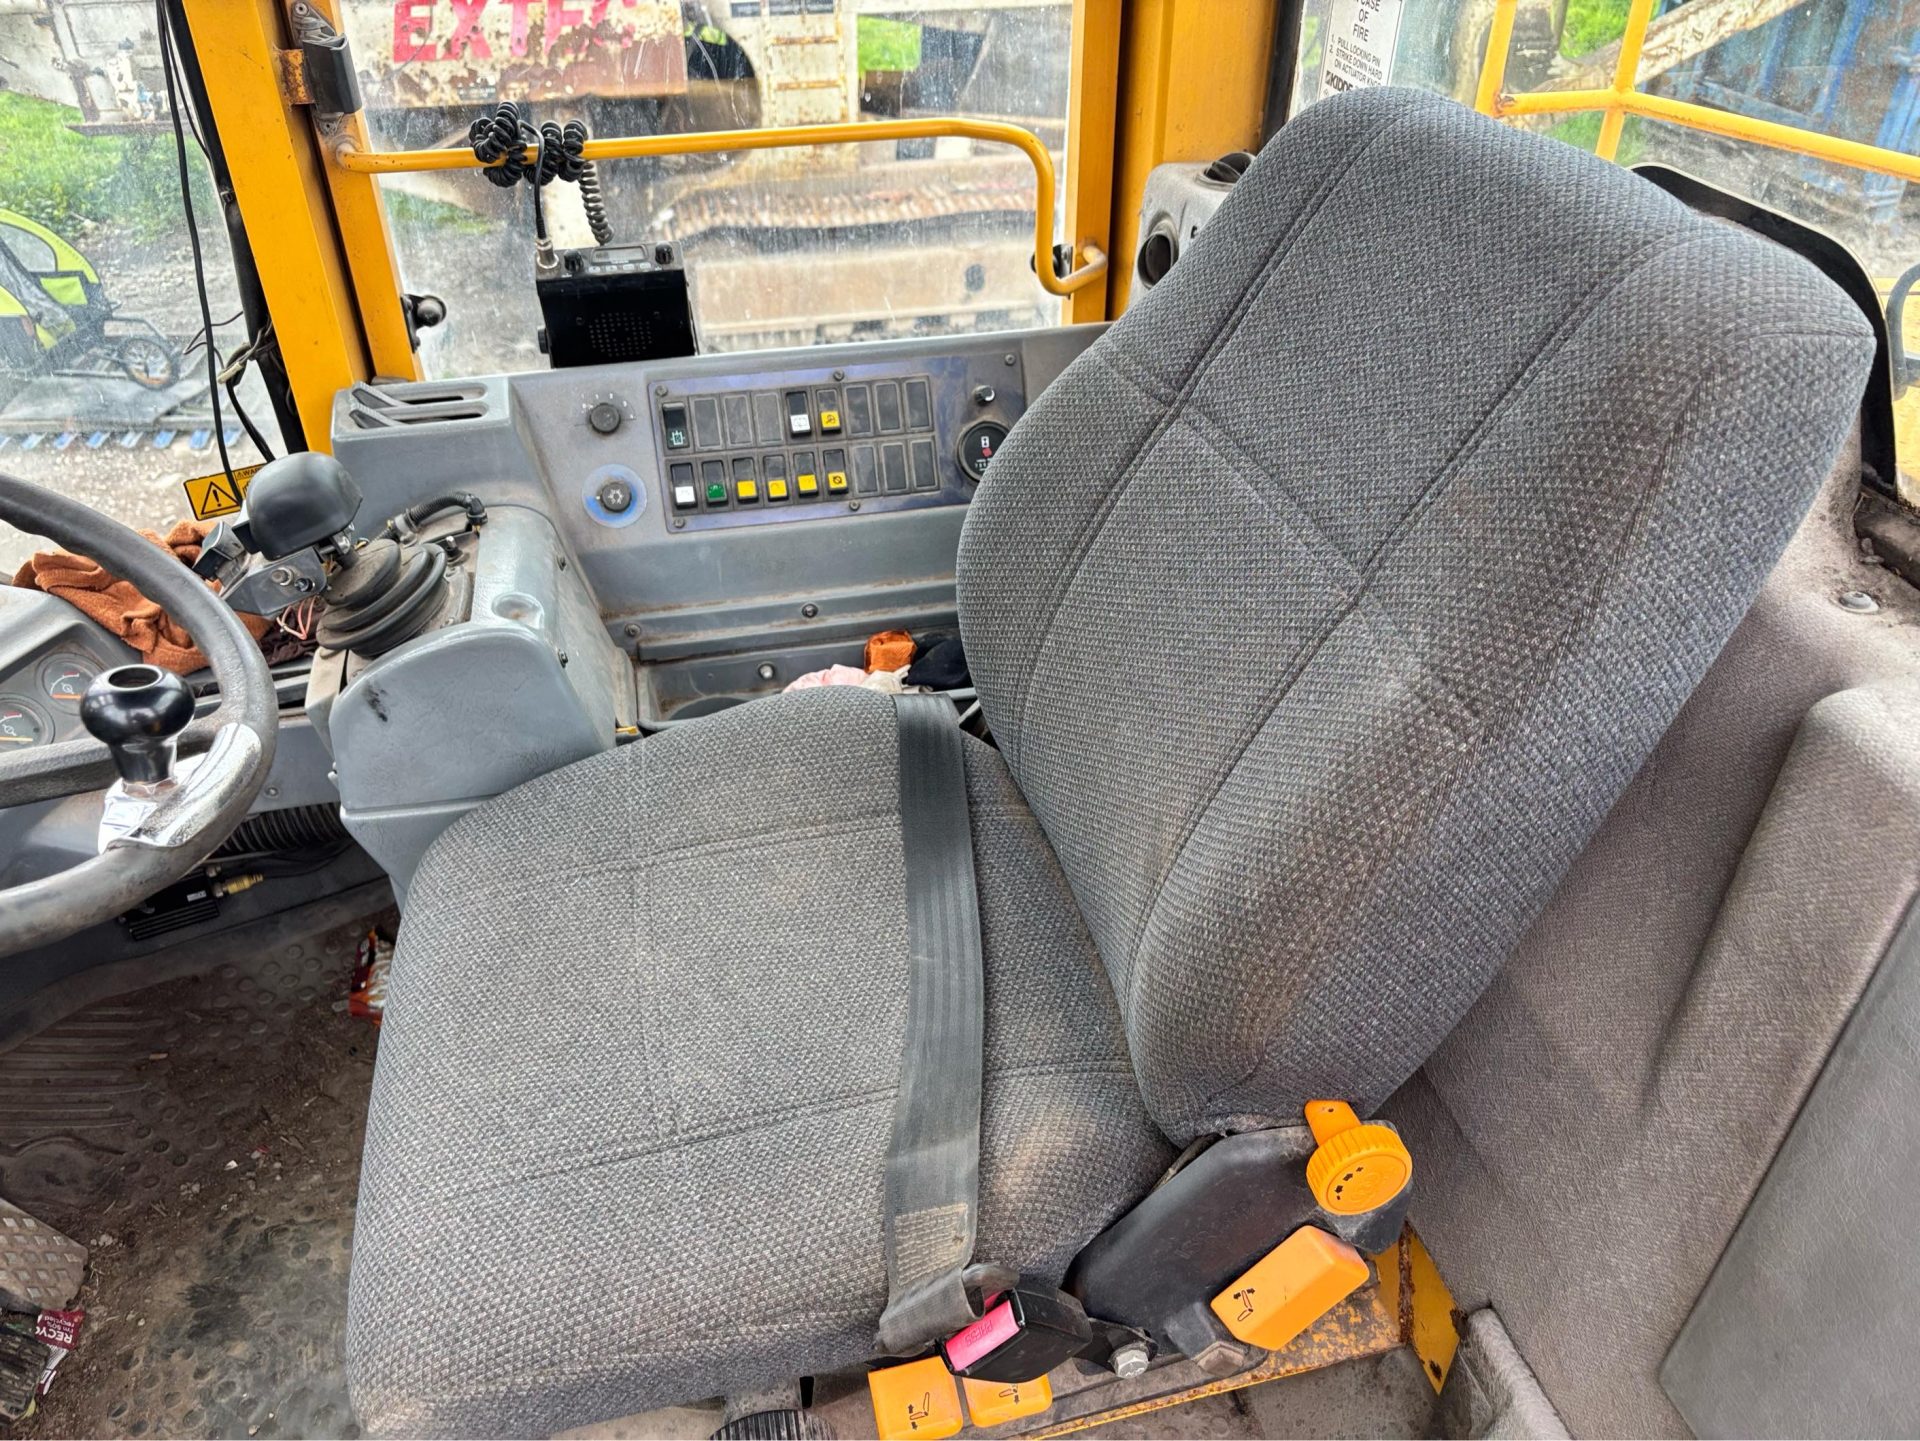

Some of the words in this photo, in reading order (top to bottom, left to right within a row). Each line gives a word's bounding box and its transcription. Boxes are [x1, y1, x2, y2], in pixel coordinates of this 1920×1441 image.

[1358, 8, 1370, 24] OF
[1352, 23, 1369, 42] FIRE
[1337, 36, 1349, 51] PULL
[1349, 43, 1372, 63] LOCKING
[1371, 55, 1382, 68] PIN
[1334, 58, 1342, 70] ON
[1342, 63, 1367, 83] ACTUATOR
[1335, 47, 1353, 64] STRIKE
[1352, 57, 1368, 73] DOWN
[1367, 64, 1383, 80] HARD
[44, 1315, 75, 1328] recycled
